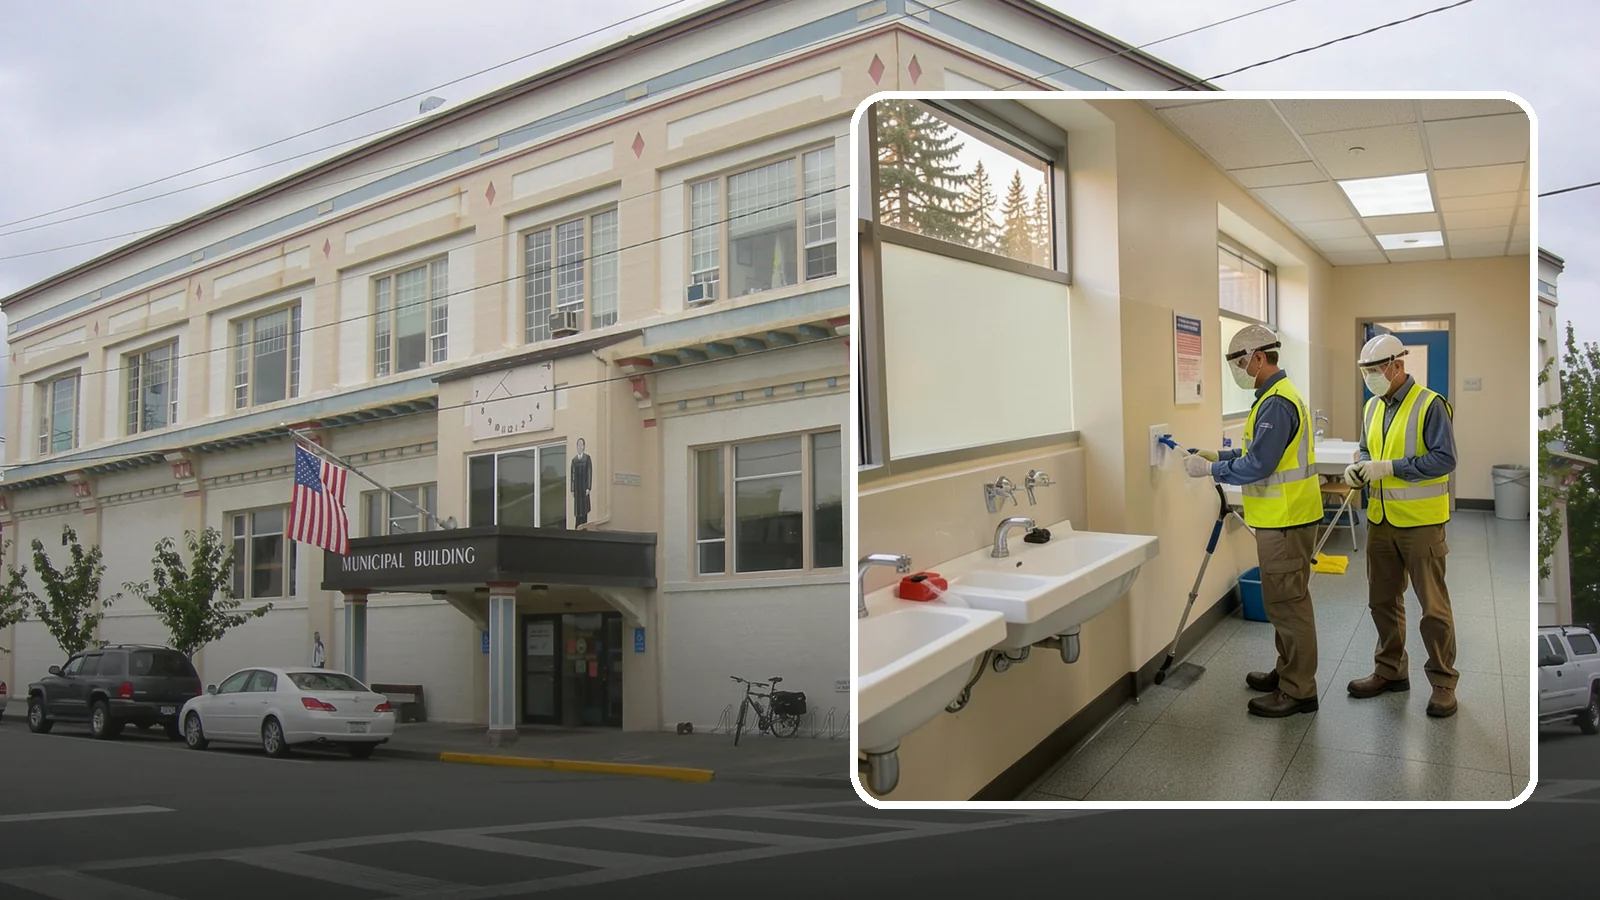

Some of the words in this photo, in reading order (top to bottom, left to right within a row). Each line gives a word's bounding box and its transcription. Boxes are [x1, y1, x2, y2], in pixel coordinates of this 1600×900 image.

[475, 389, 479, 398] 7
[481, 406, 485, 415] 8
[536, 402, 540, 410] 4
[488, 417, 492, 426] 9
[529, 414, 533, 422] 3
[494, 423, 500, 432] 10
[521, 420, 525, 428] 2
[507, 425, 513, 433] 12
[342, 552, 405, 572] MUNICIPAL
[414, 546, 475, 567] BUILDING
